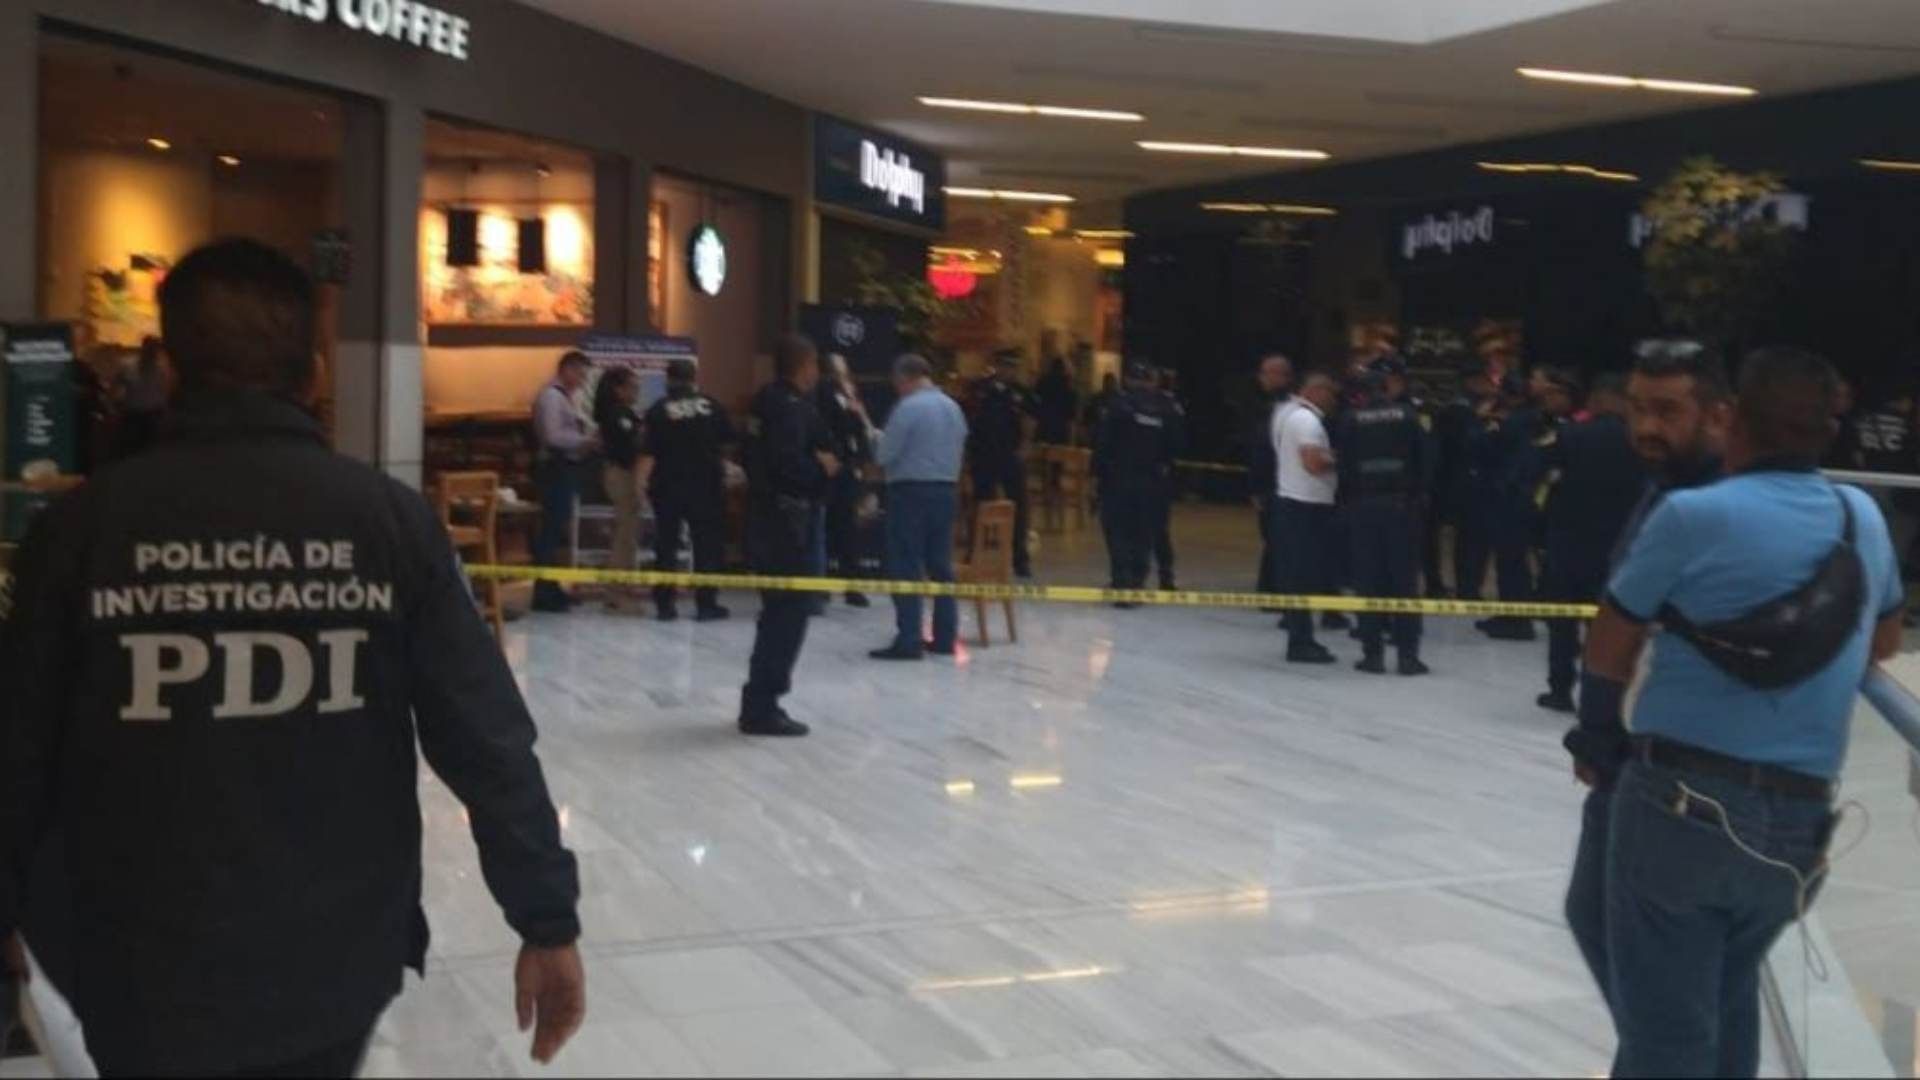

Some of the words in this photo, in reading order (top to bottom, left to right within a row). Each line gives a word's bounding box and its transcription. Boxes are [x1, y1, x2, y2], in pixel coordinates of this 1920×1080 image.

[335, 0, 469, 60] COFFEE
[861, 139, 924, 214] Dolphy
[134, 533, 293, 572] POLICÍA
[303, 539, 354, 570] DE
[93, 575, 395, 619] INVESTIGACIÓN
[119, 629, 369, 721] PDI
